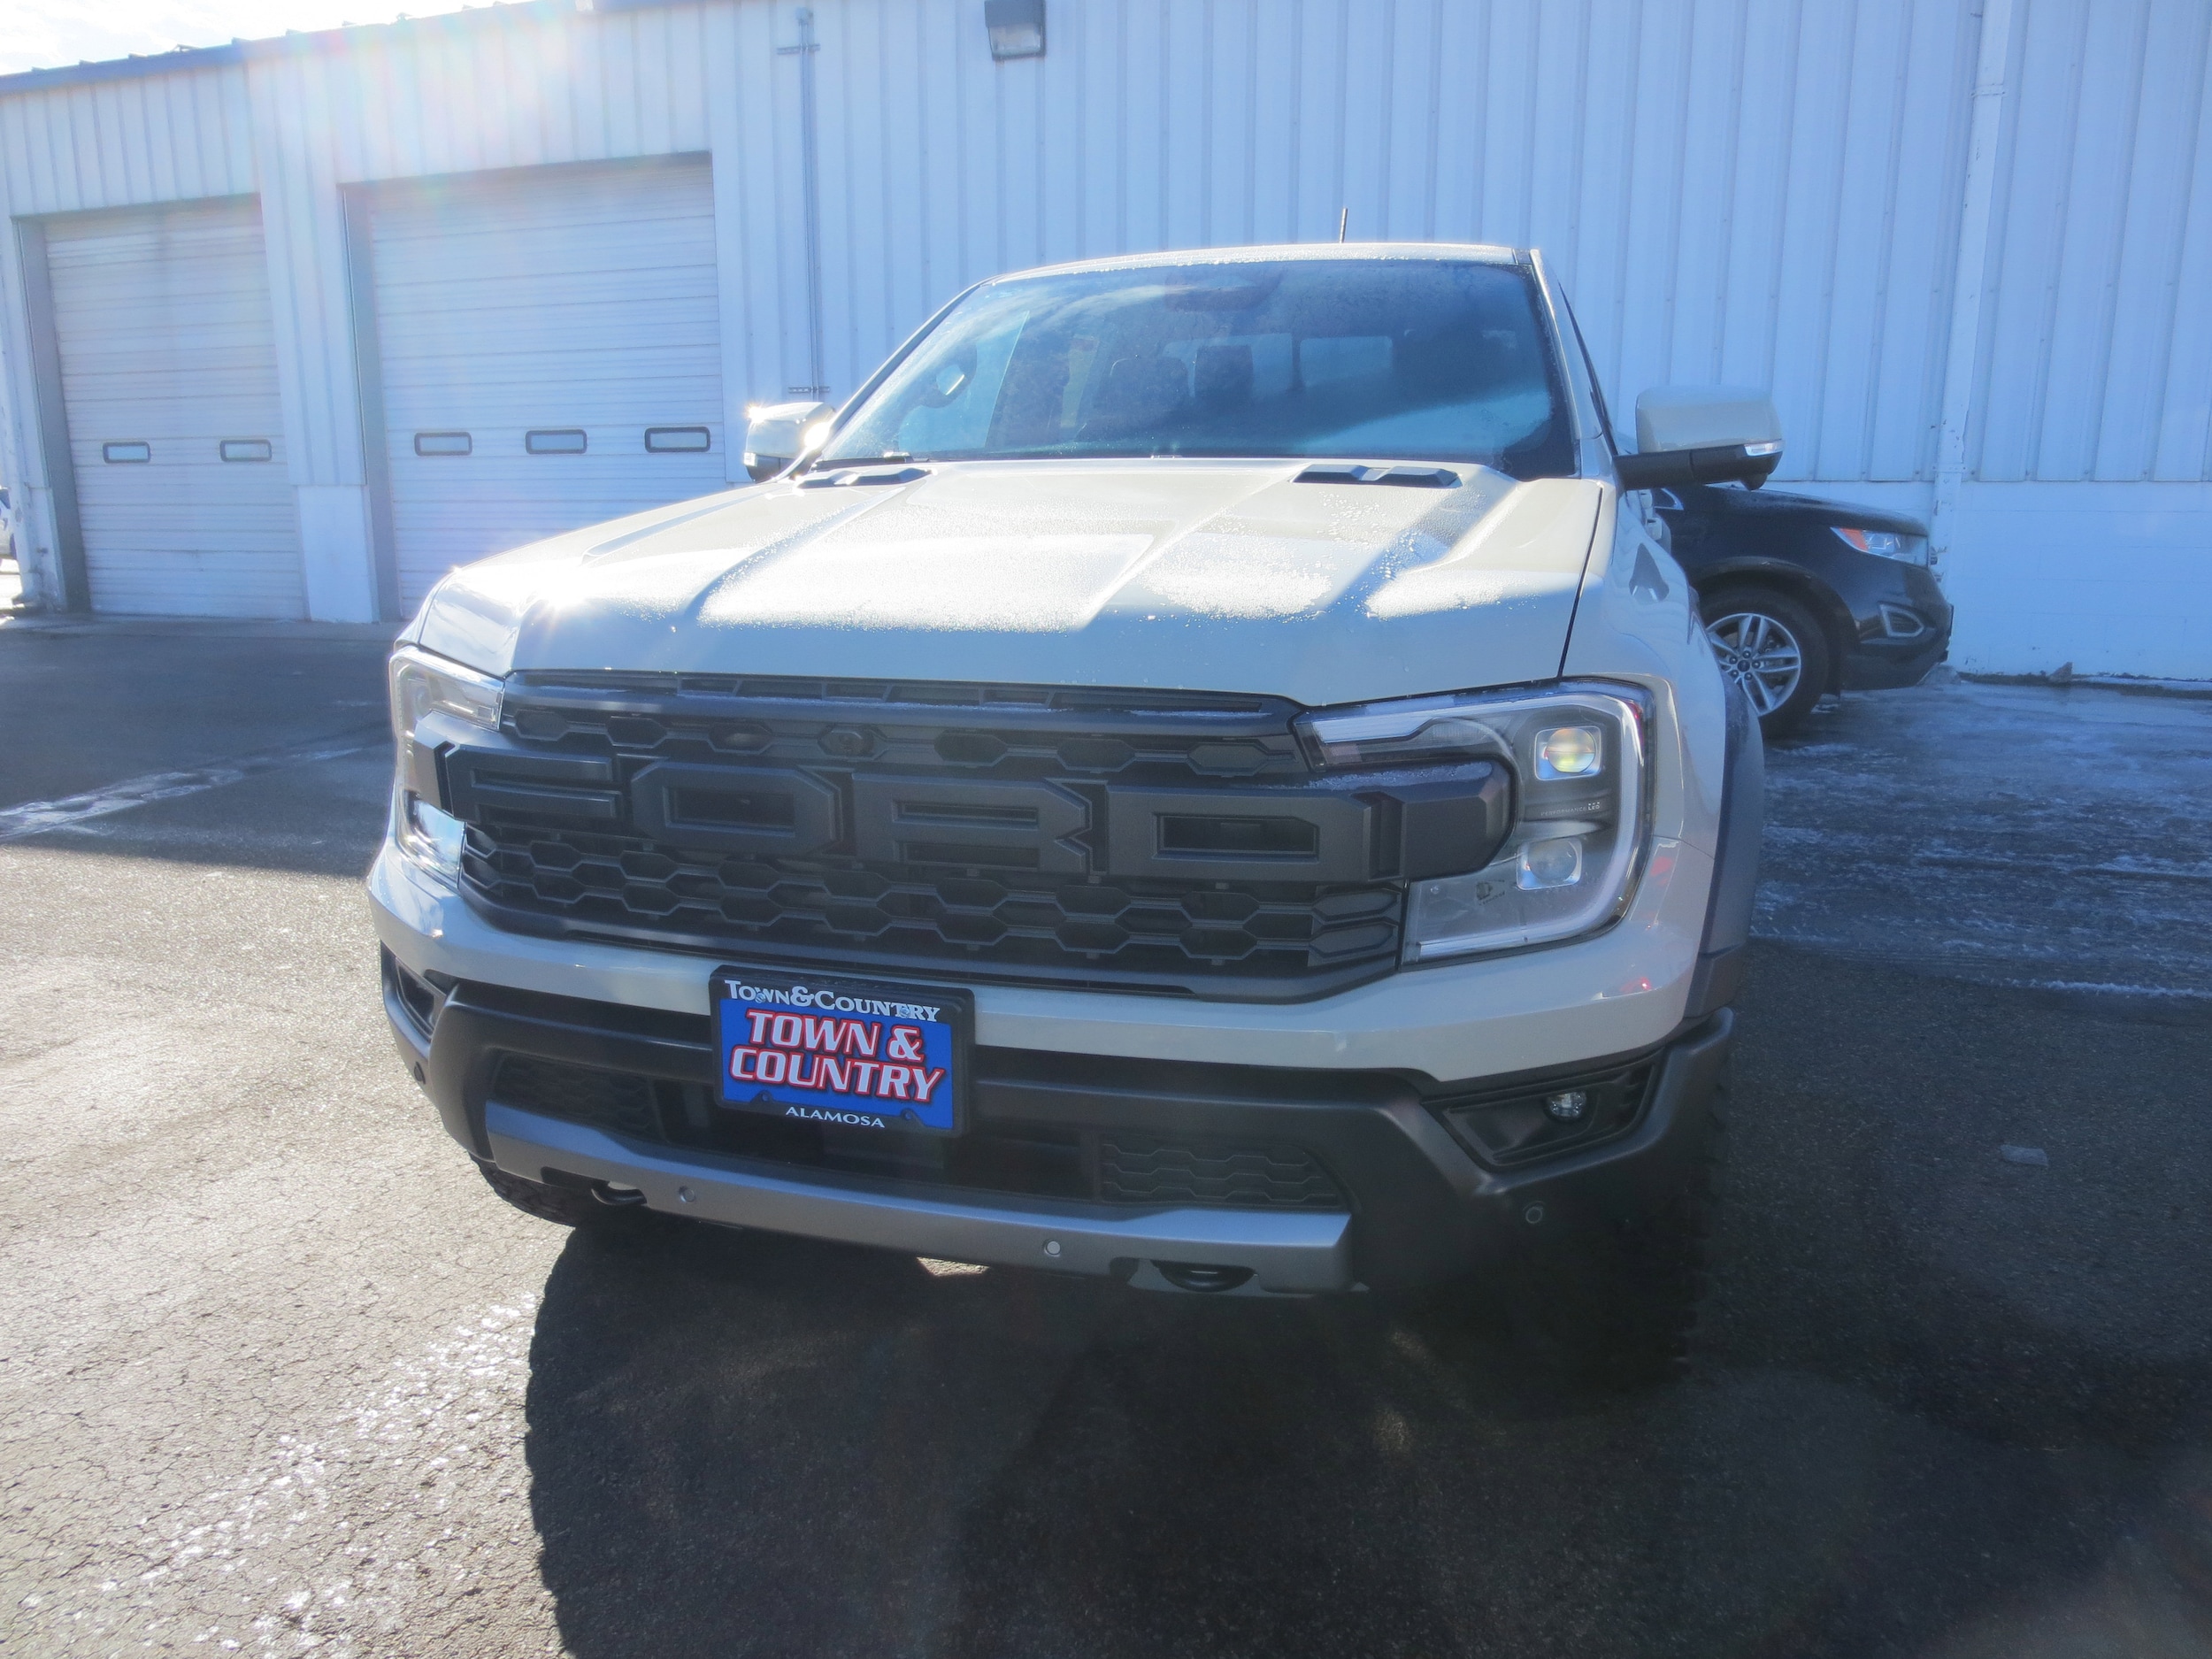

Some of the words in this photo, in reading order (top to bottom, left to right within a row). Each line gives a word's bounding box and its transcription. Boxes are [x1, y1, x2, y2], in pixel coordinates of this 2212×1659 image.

[445, 744, 1371, 882] FORD
[746, 1009, 881, 1057] TOWN
[887, 1025, 925, 1062] &
[729, 1045, 944, 1102] COUNTRY
[786, 1106, 886, 1128] ALAMOSA
